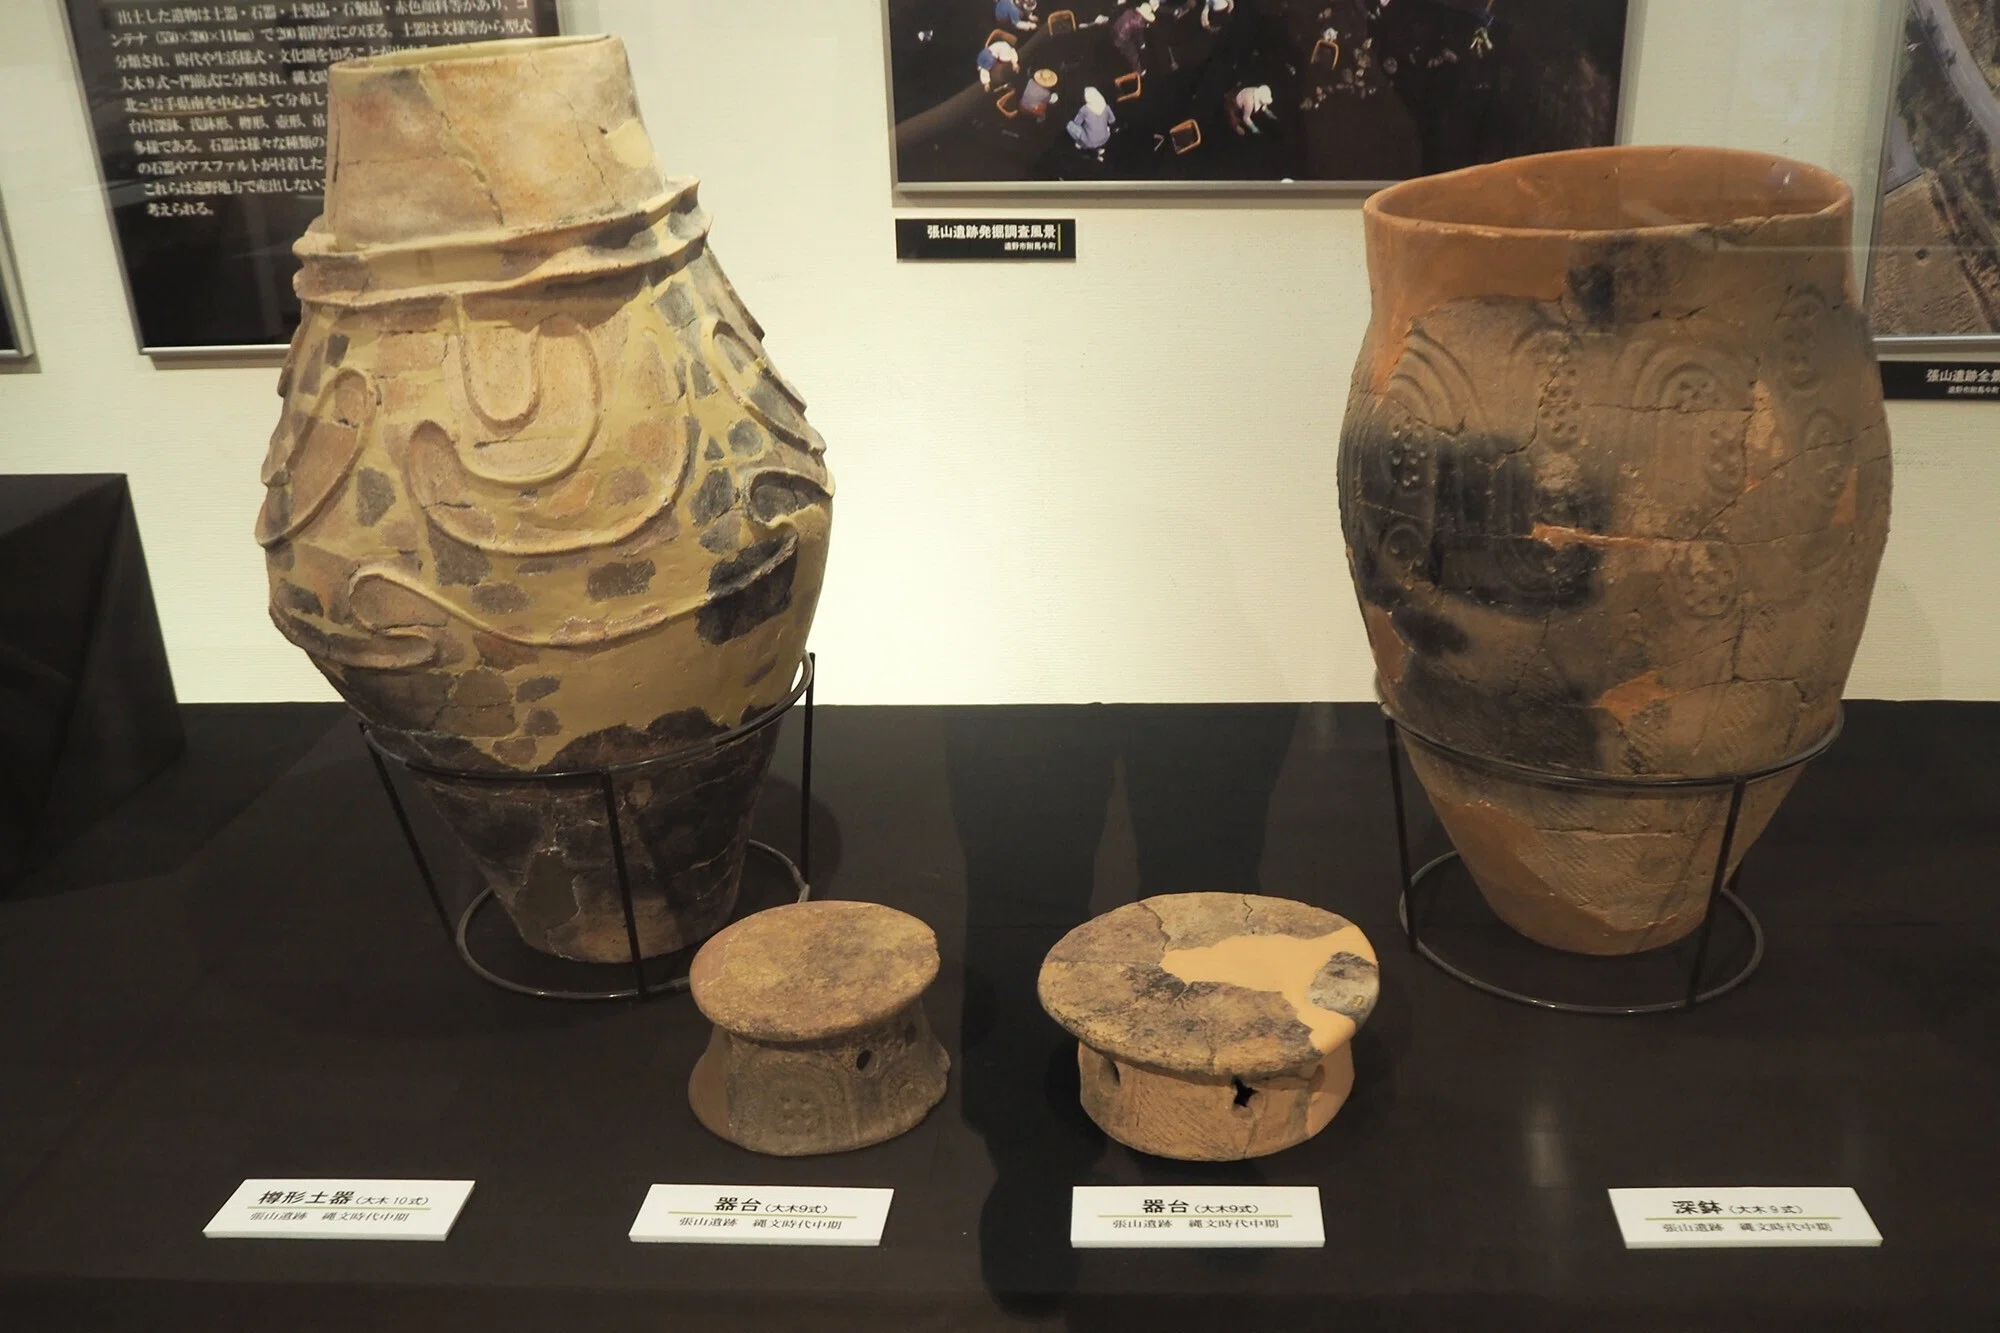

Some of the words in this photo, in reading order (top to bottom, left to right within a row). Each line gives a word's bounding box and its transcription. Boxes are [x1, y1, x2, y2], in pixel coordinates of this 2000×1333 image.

[147, 202, 214, 217] 考えられる。
[927, 224, 1056, 240] 張山遺跡発掘調査風景
[714, 1196, 829, 1214] 器台（大木9式）
[1142, 1199, 1259, 1214] 器台（大木9式）
[250, 1211, 308, 1222] 張山遺跡
[321, 1211, 410, 1222] 縄文時代中期
[679, 1216, 739, 1228] 張山遺跡
[752, 1218, 843, 1230] 縄文時代中期
[1113, 1219, 1173, 1229] 張山遺跡
[1188, 1219, 1280, 1229] 縄文時代中期
[1661, 1222, 1725, 1233] 張山遺跡
[1738, 1222, 1833, 1233] 縄文時代中期
